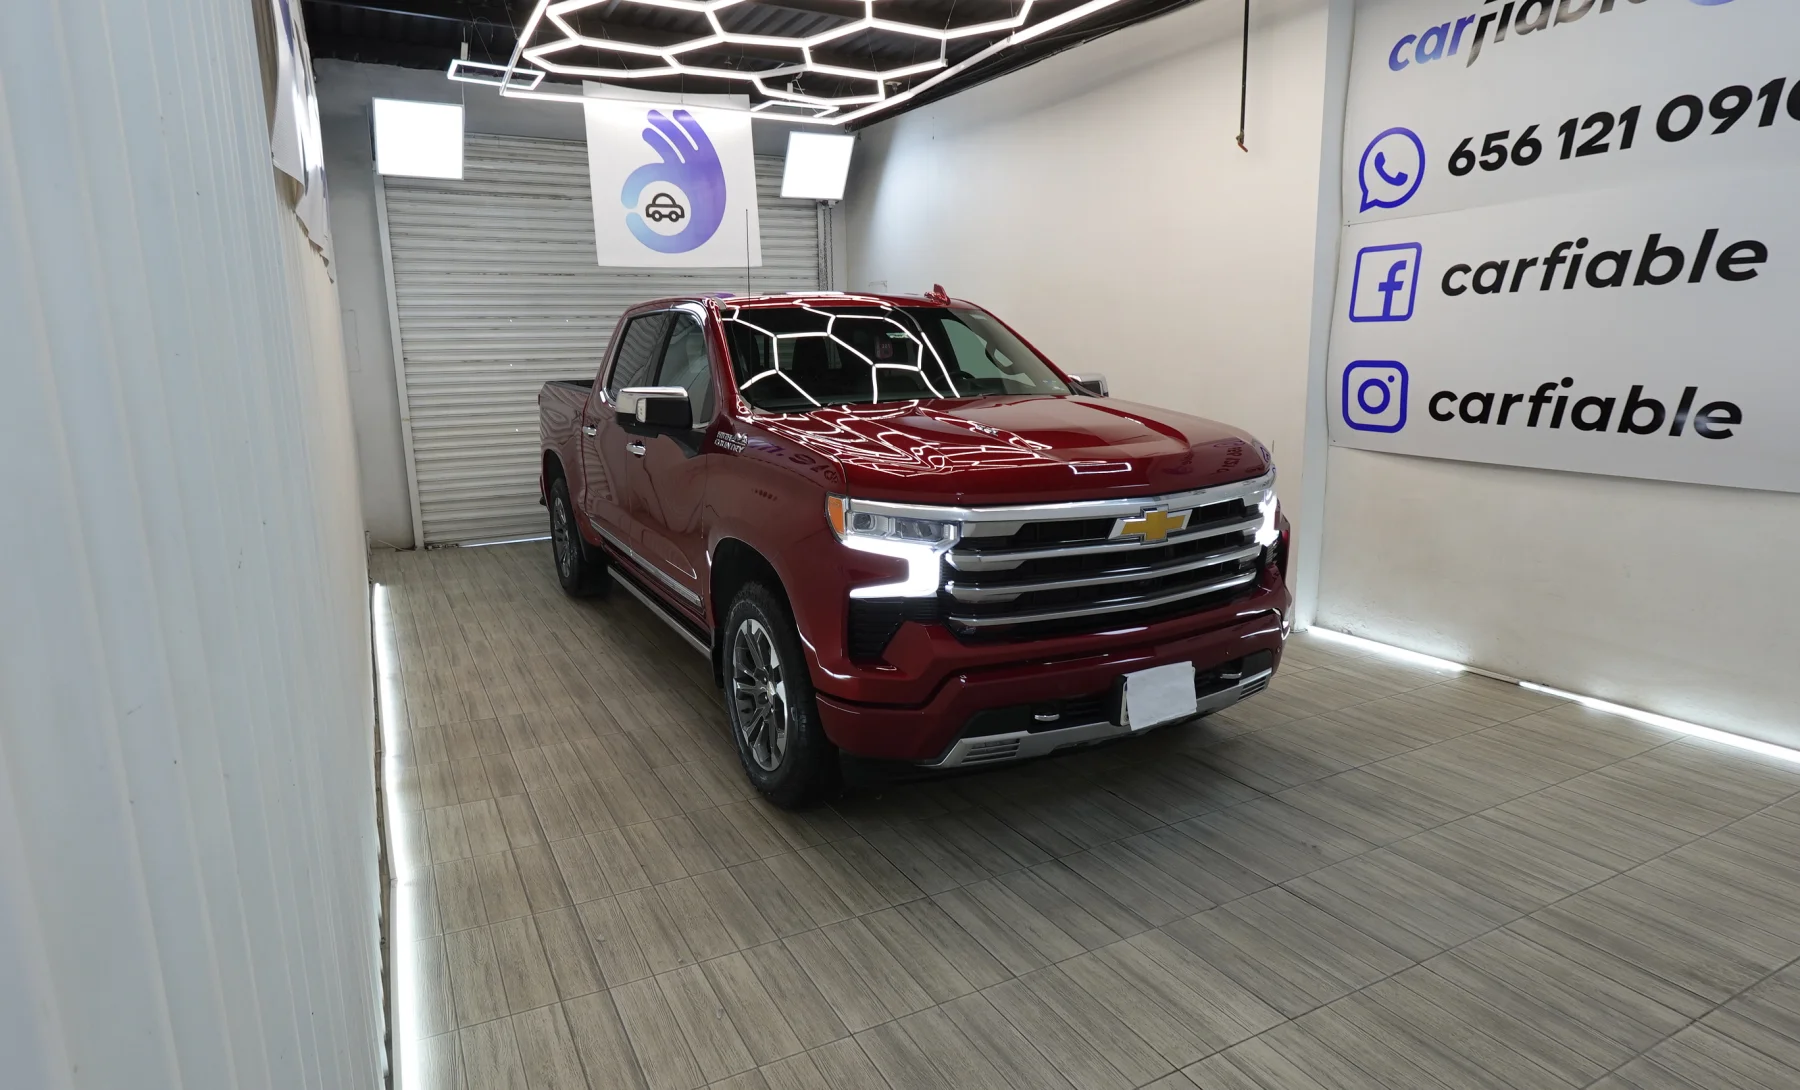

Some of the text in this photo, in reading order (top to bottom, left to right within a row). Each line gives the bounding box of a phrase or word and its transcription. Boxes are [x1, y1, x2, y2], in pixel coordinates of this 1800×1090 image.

[1389, 0, 1648, 71] carfia
[1447, 124, 1543, 177] 656
[1558, 105, 1642, 161] 121
[1441, 228, 1769, 297] carfiable
[1428, 377, 1743, 440] carfiable
